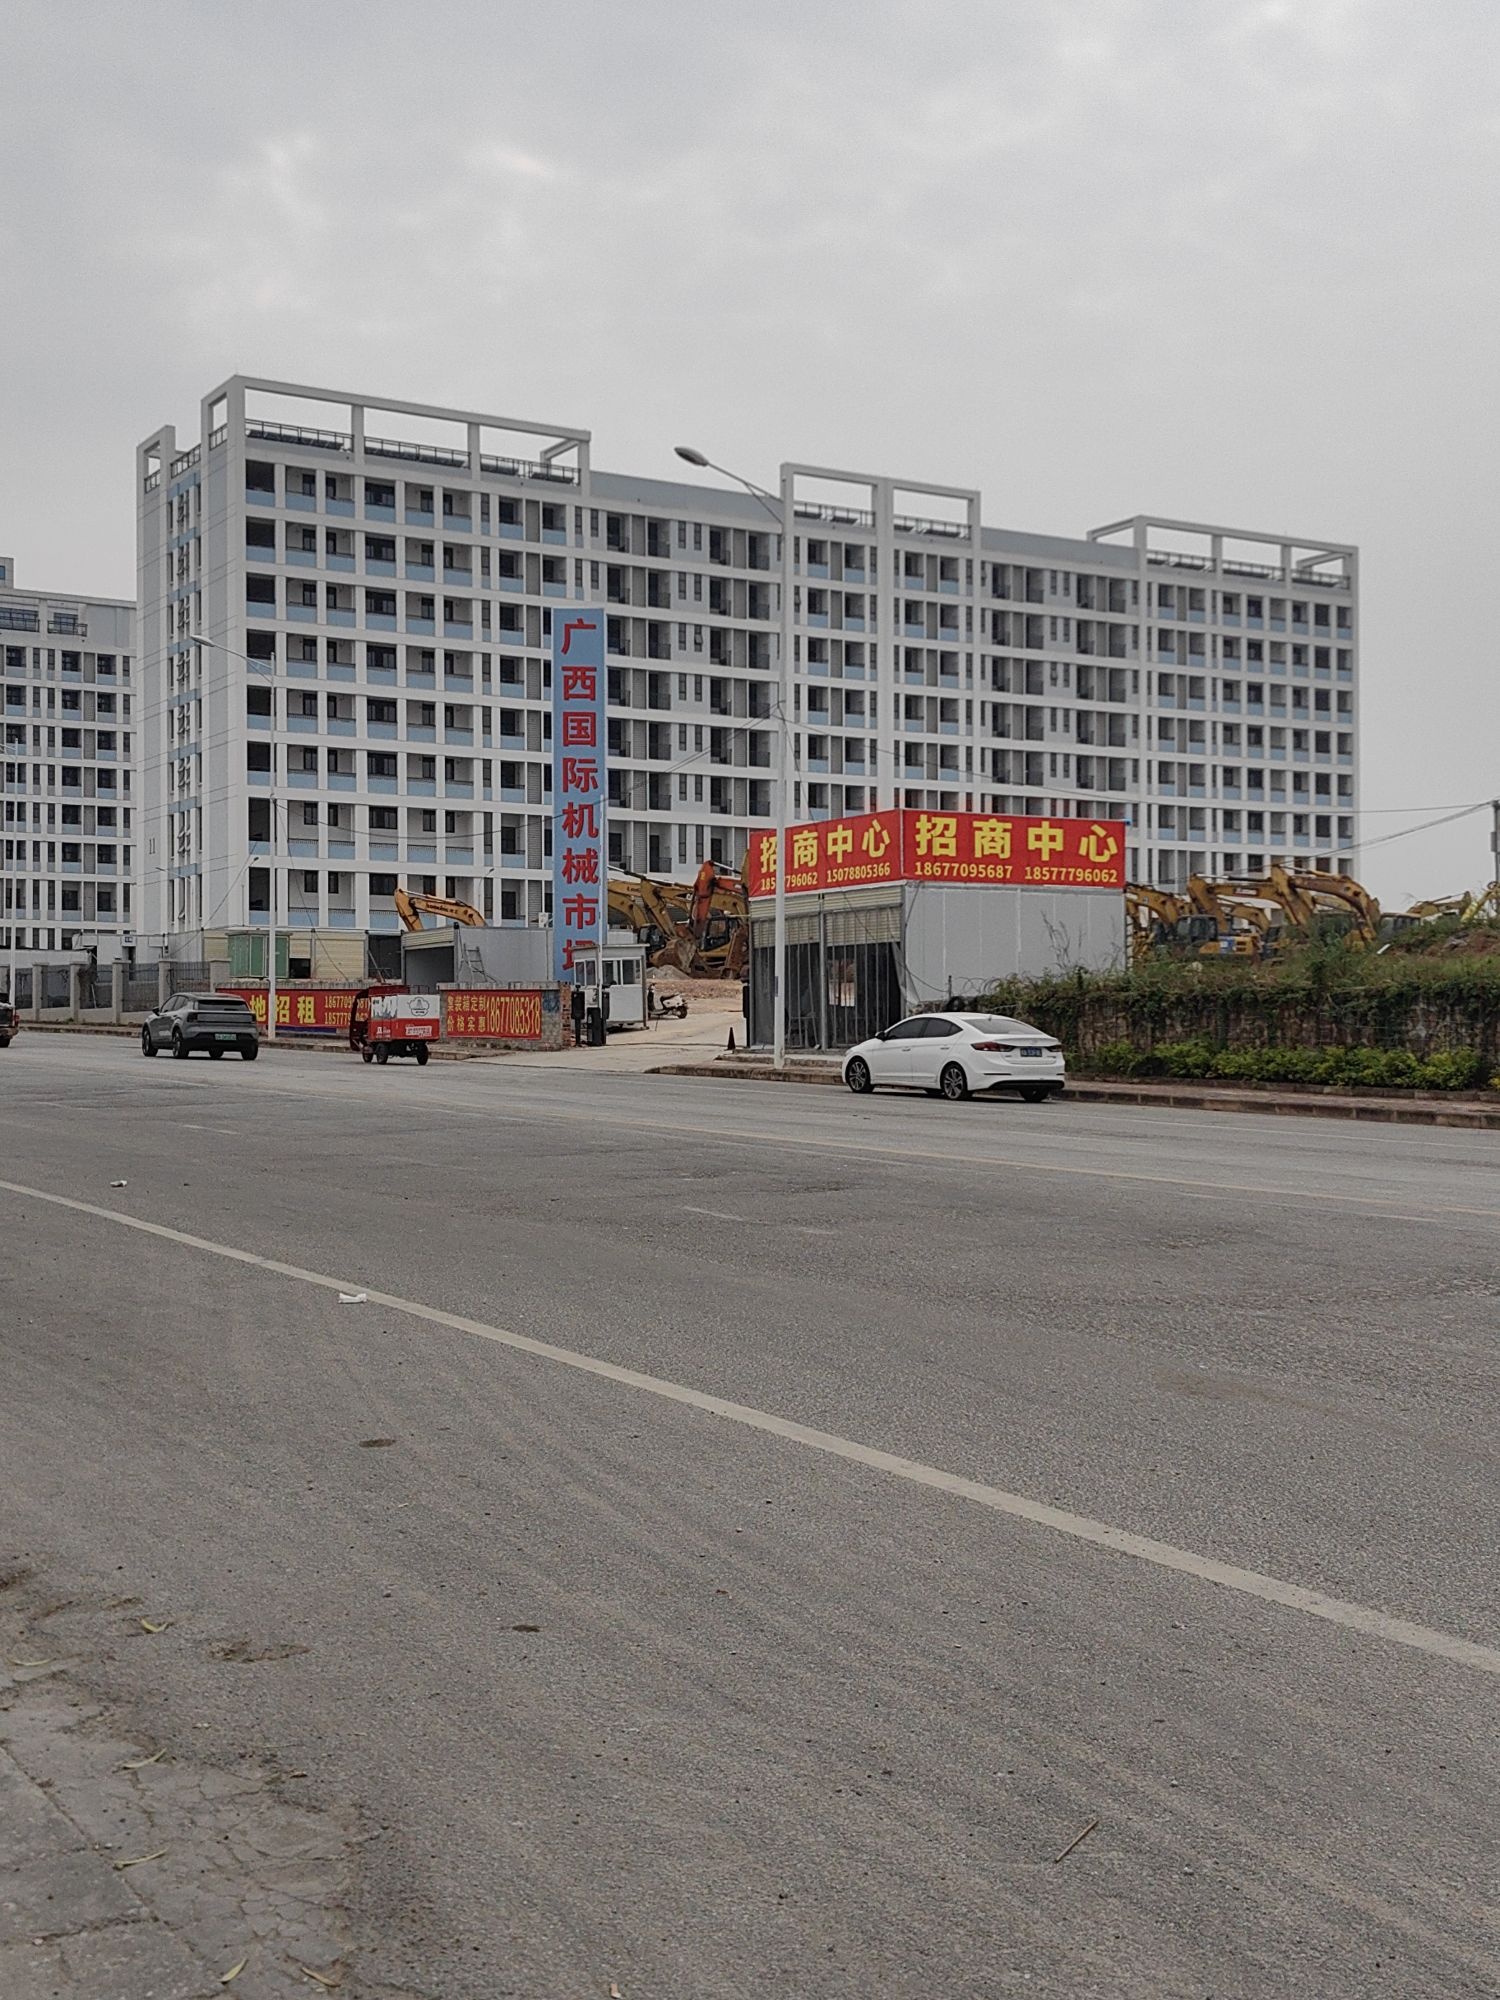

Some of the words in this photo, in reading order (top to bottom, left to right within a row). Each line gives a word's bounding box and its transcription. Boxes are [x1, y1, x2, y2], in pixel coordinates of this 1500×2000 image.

[760, 819, 891, 873] 招商中心
[915, 814, 1118, 862] 招商中心
[760, 872, 818, 891] 185796062
[826, 862, 891, 883] 15078805366
[915, 861, 1013, 879] 18677095687
[1024, 866, 1118, 883] 18577796062
[447, 994, 486, 1012] 集装箱定制
[447, 1014, 486, 1033] 价格实惠
